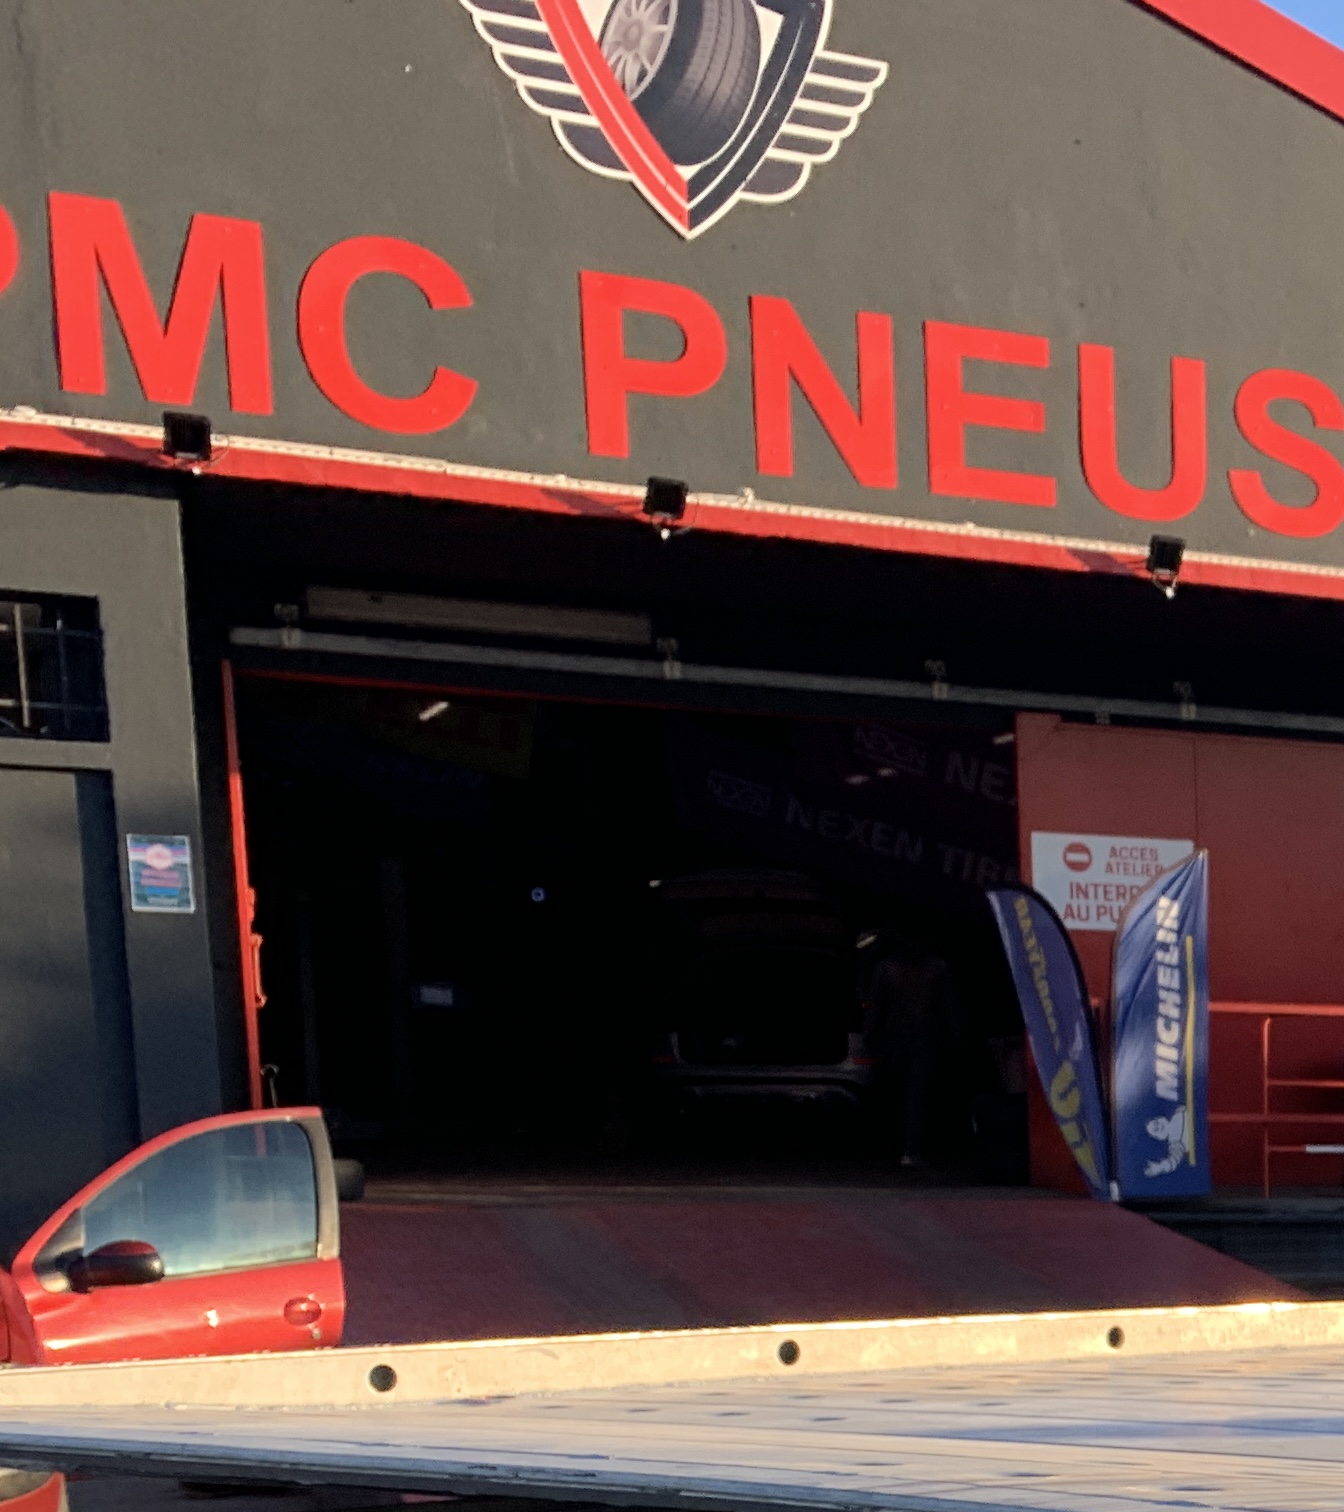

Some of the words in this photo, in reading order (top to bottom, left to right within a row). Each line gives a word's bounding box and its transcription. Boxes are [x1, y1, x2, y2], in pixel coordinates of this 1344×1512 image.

[0, 191, 479, 435] MC
[785, 791, 924, 865] NEXEN
[1063, 903, 1089, 921] AU
[1155, 896, 1182, 1102] MICHELIN
